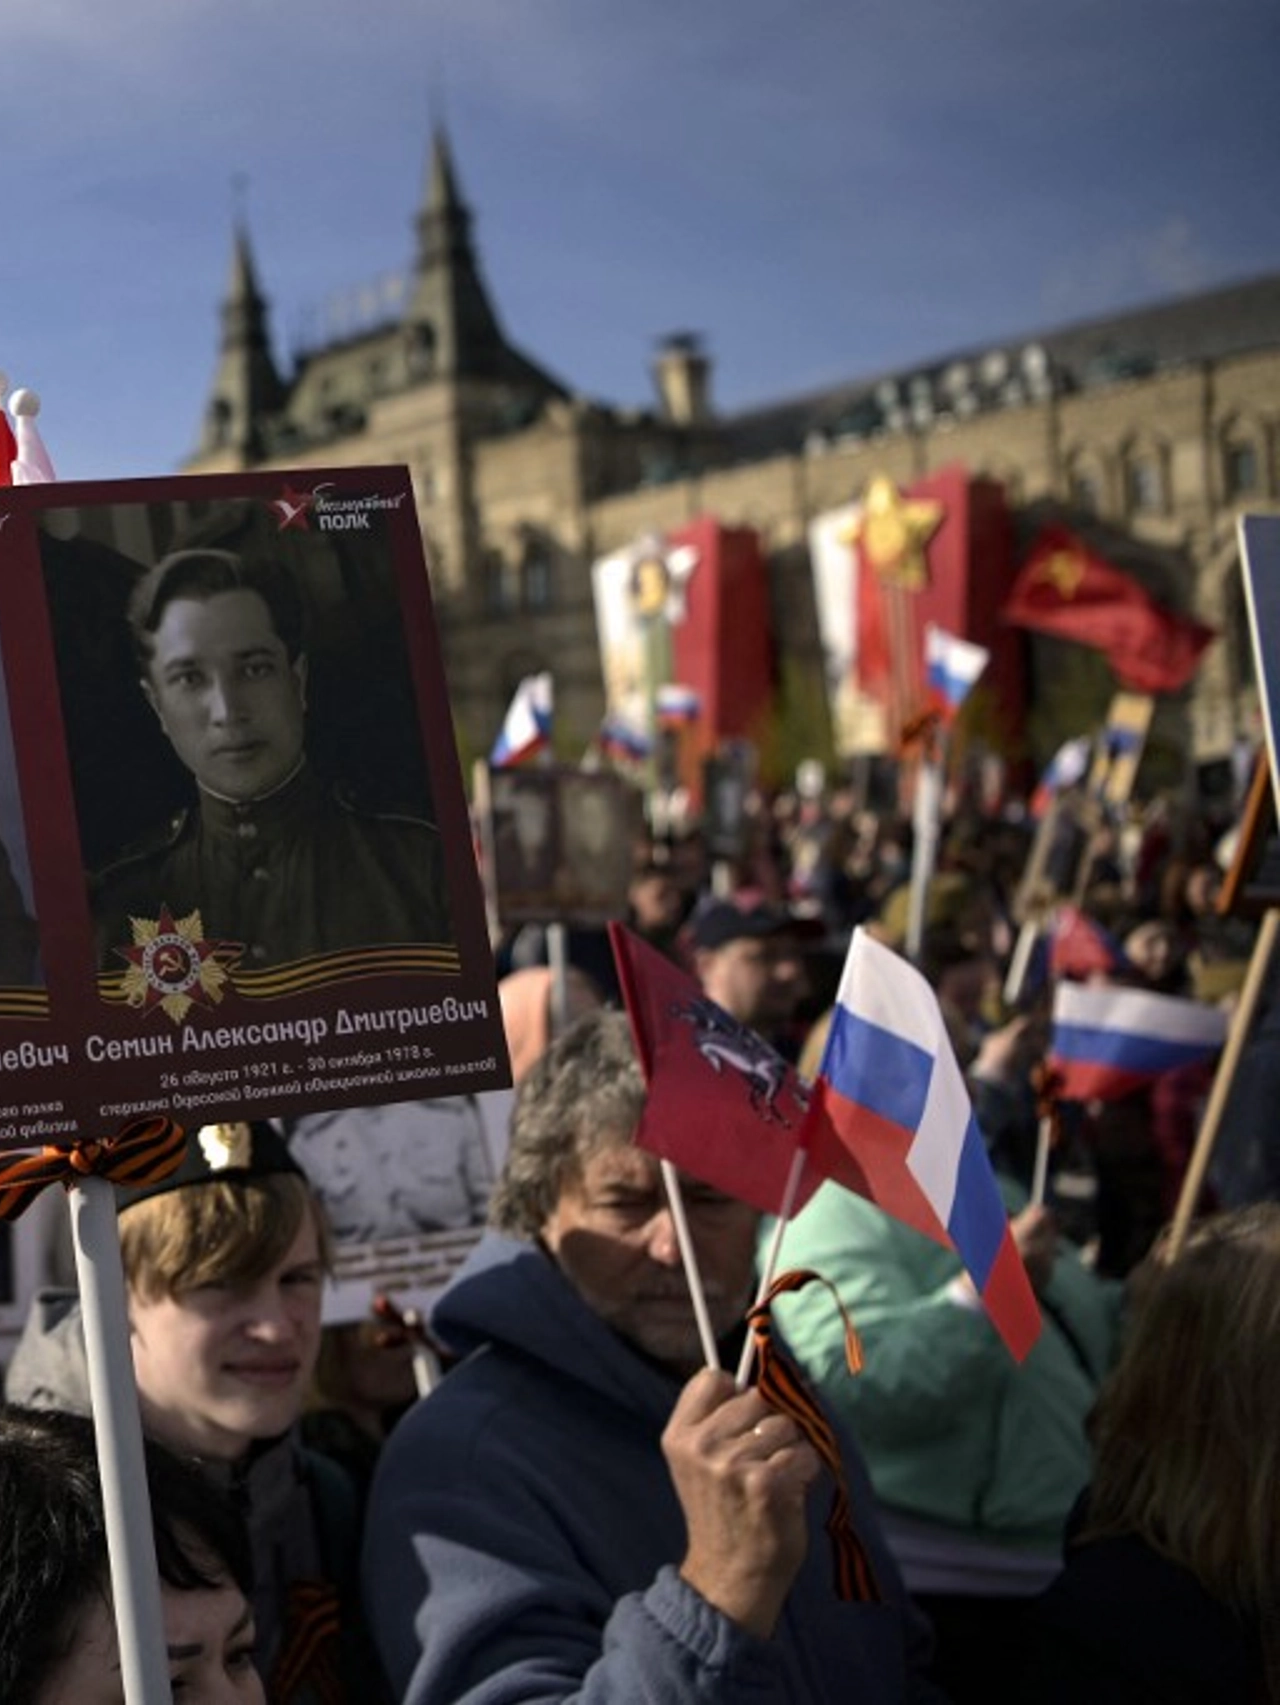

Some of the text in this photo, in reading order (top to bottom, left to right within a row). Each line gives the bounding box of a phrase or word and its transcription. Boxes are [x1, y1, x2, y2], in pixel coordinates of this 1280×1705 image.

[320, 513, 369, 530] ПОЛК
[86, 997, 487, 1061] Семин Александр Дмитриевич
[160, 1073, 178, 1088] 26
[243, 1063, 276, 1077] 1921
[308, 1056, 326, 1071] 30
